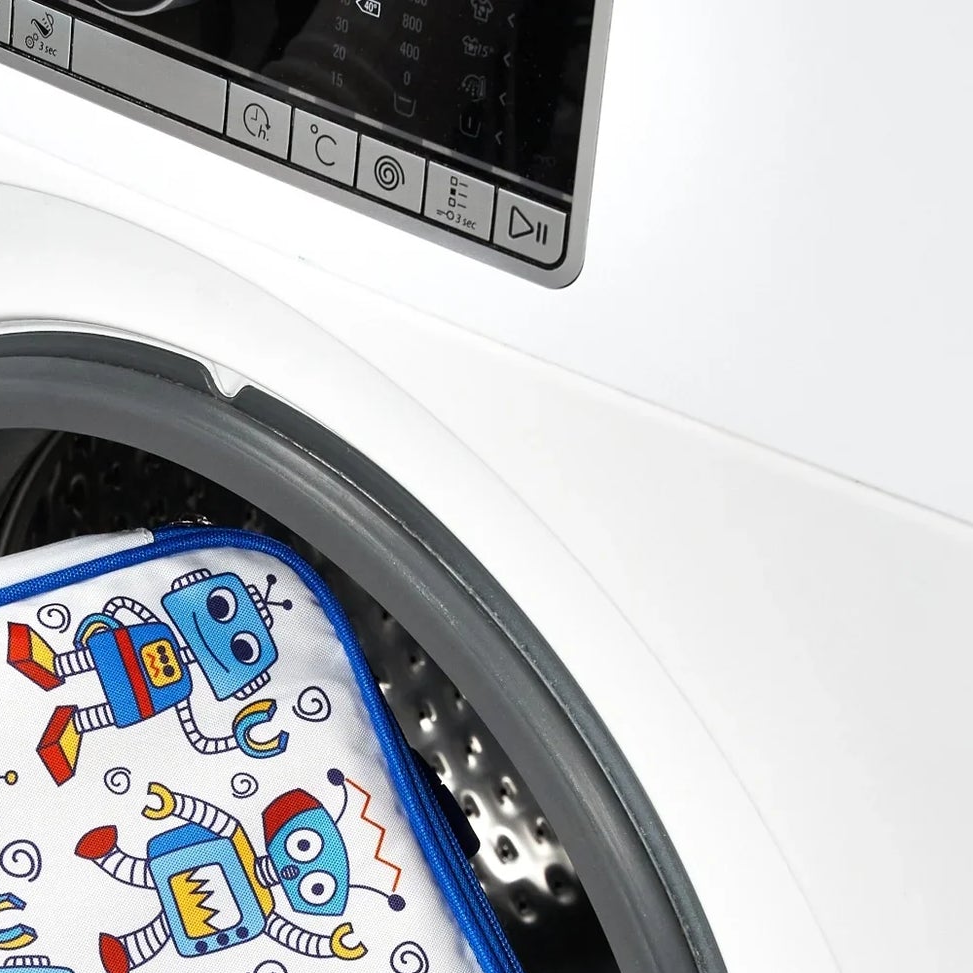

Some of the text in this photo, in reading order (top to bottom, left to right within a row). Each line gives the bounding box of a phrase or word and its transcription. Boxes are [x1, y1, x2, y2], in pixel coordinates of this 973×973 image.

[335, 16, 348, 33] 30
[402, 12, 423, 33] 800
[39, 41, 57, 57] 3 sec
[333, 43, 346, 61] 20
[399, 41, 420, 61] 400
[331, 72, 343, 87] 15
[403, 70, 411, 86] 0
[455, 214, 476, 230] 3 sec
